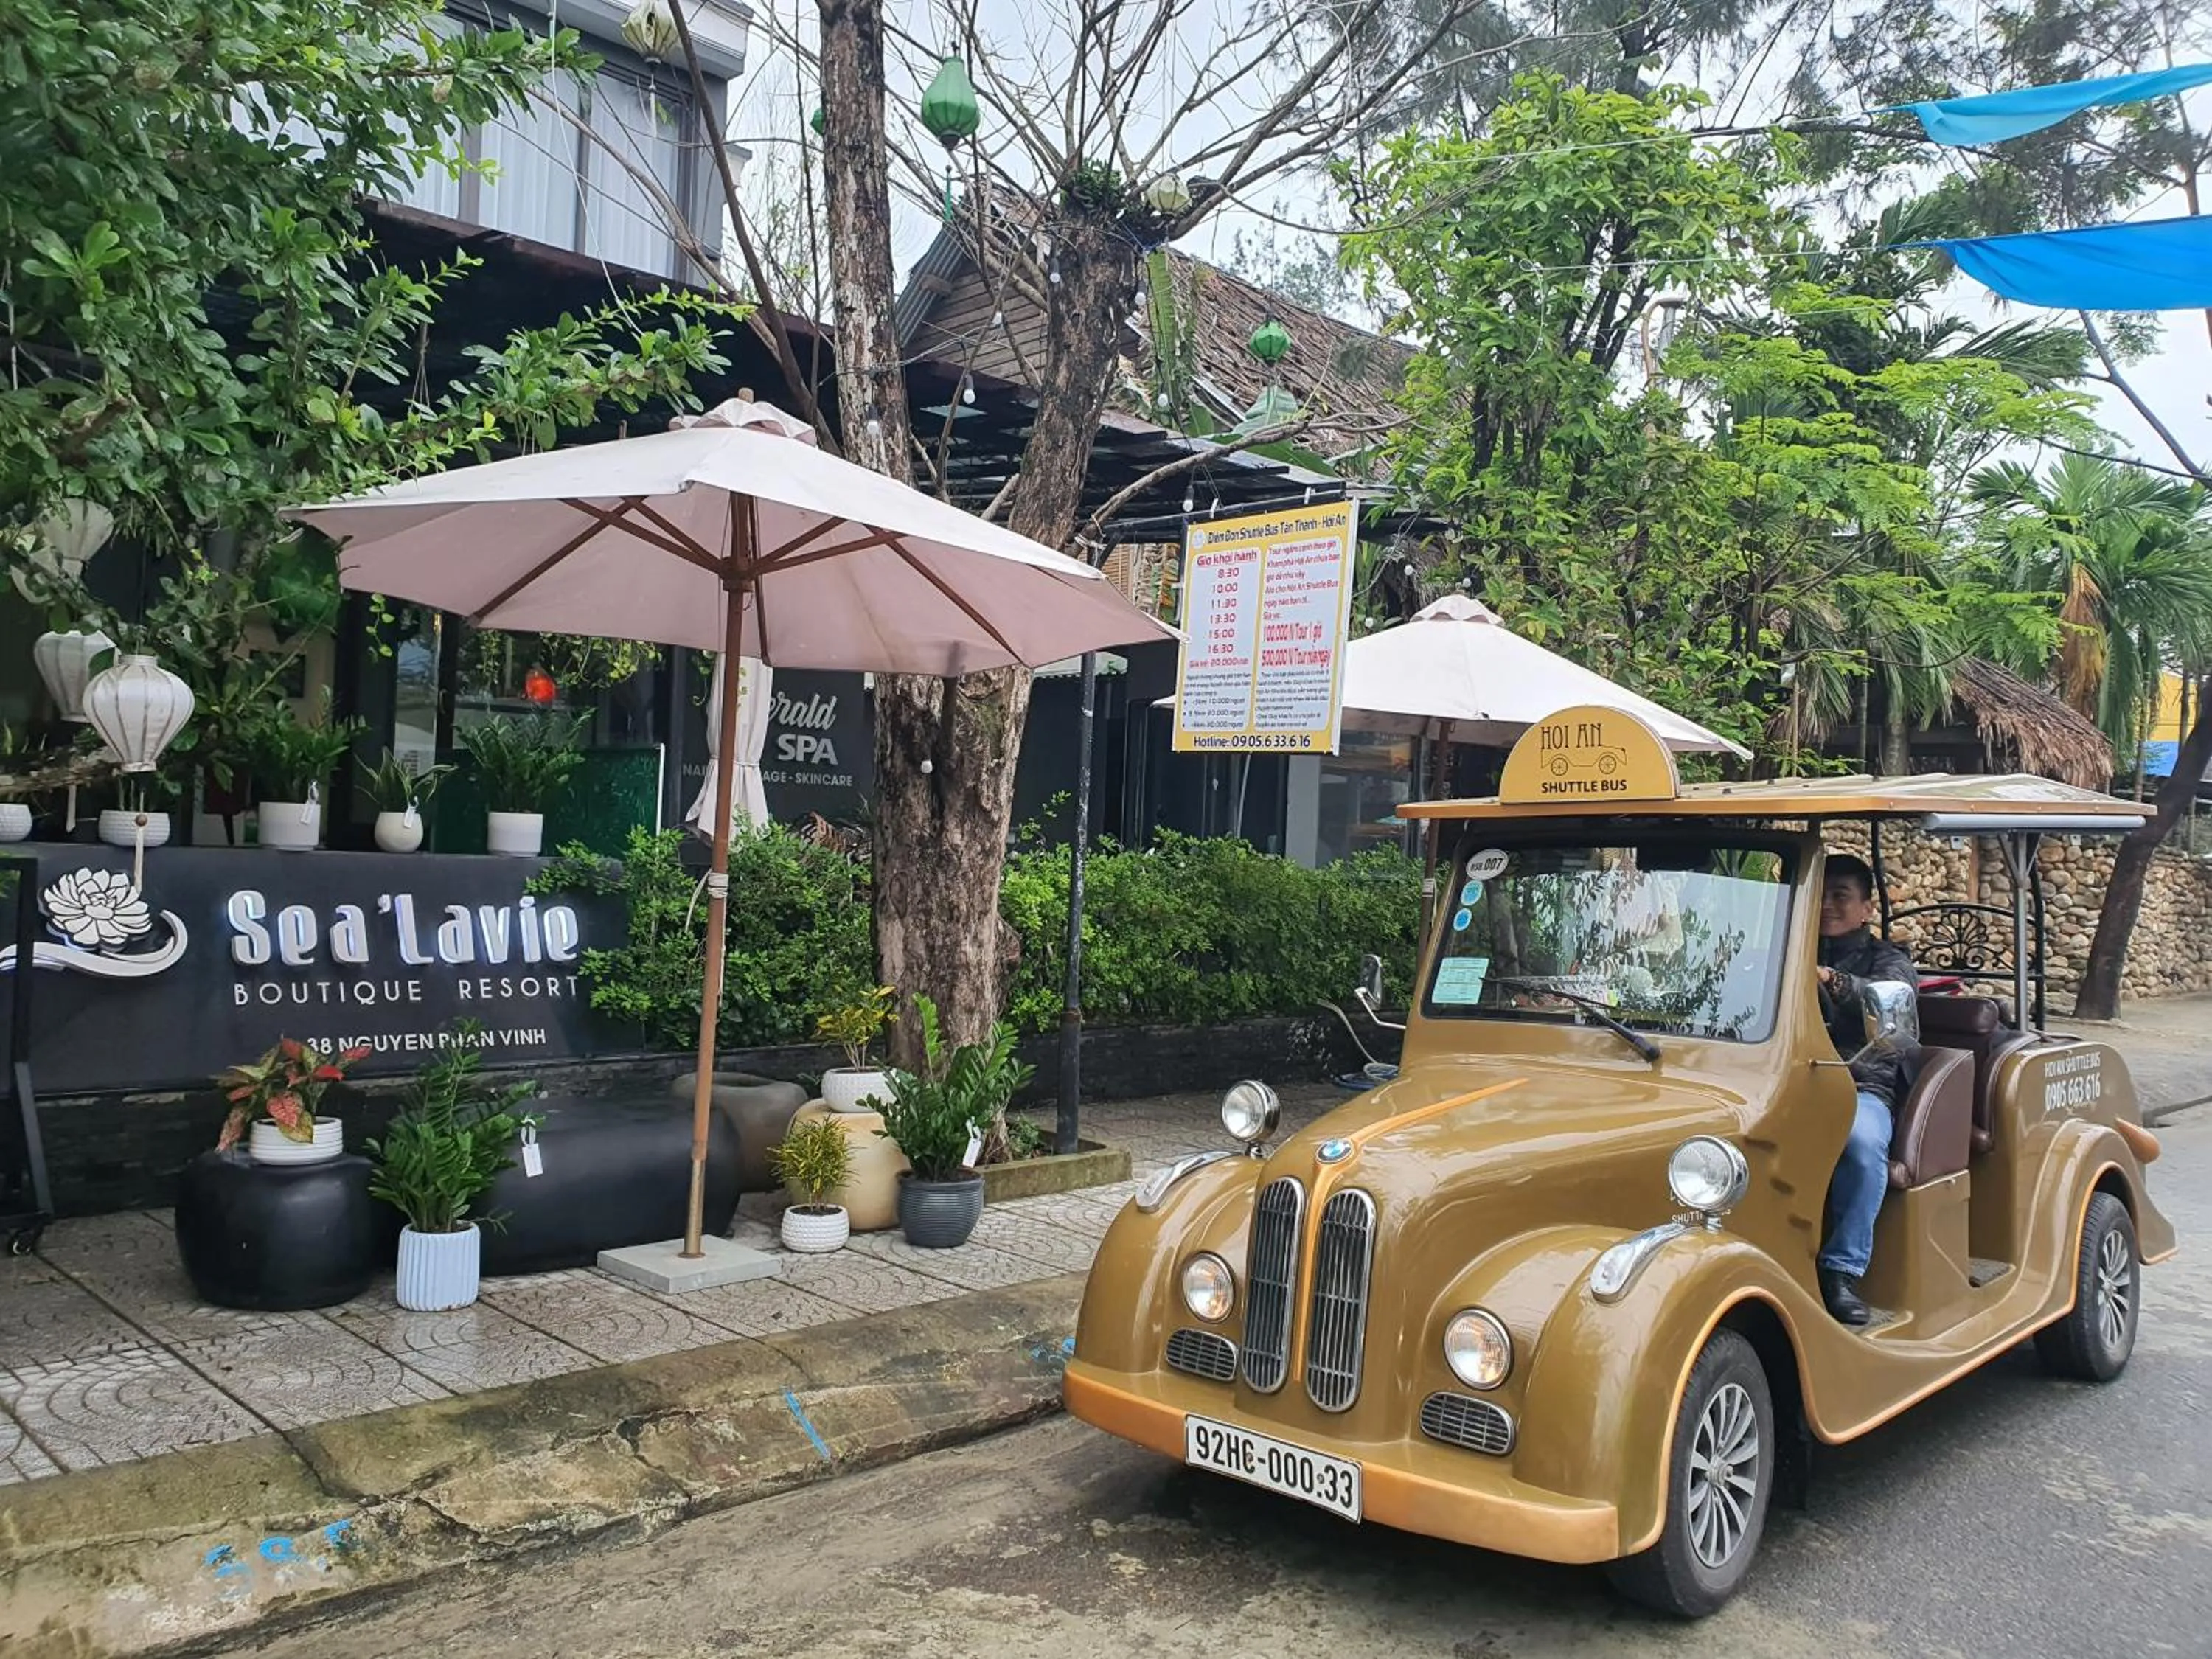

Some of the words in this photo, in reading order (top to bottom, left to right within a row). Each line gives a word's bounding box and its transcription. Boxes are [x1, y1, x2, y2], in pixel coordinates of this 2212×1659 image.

[1265, 522, 1278, 535] Bus
[1211, 582, 1237, 594] 10:00
[1208, 627, 1234, 639] 15:00
[1208, 643, 1233, 654] 16:30
[1194, 735, 1229, 747] Hotline:
[1540, 726, 1568, 750] HOI
[1576, 723, 1602, 748] AN
[778, 734, 838, 765] SPA
[1541, 780, 1597, 793] SHUTTLE
[1601, 779, 1627, 792] BUS
[234, 979, 422, 1006] BOUTIQUE
[459, 975, 579, 1001] RESORT
[338, 1033, 434, 1054] NGUYEN
[499, 1029, 546, 1046] VINH
